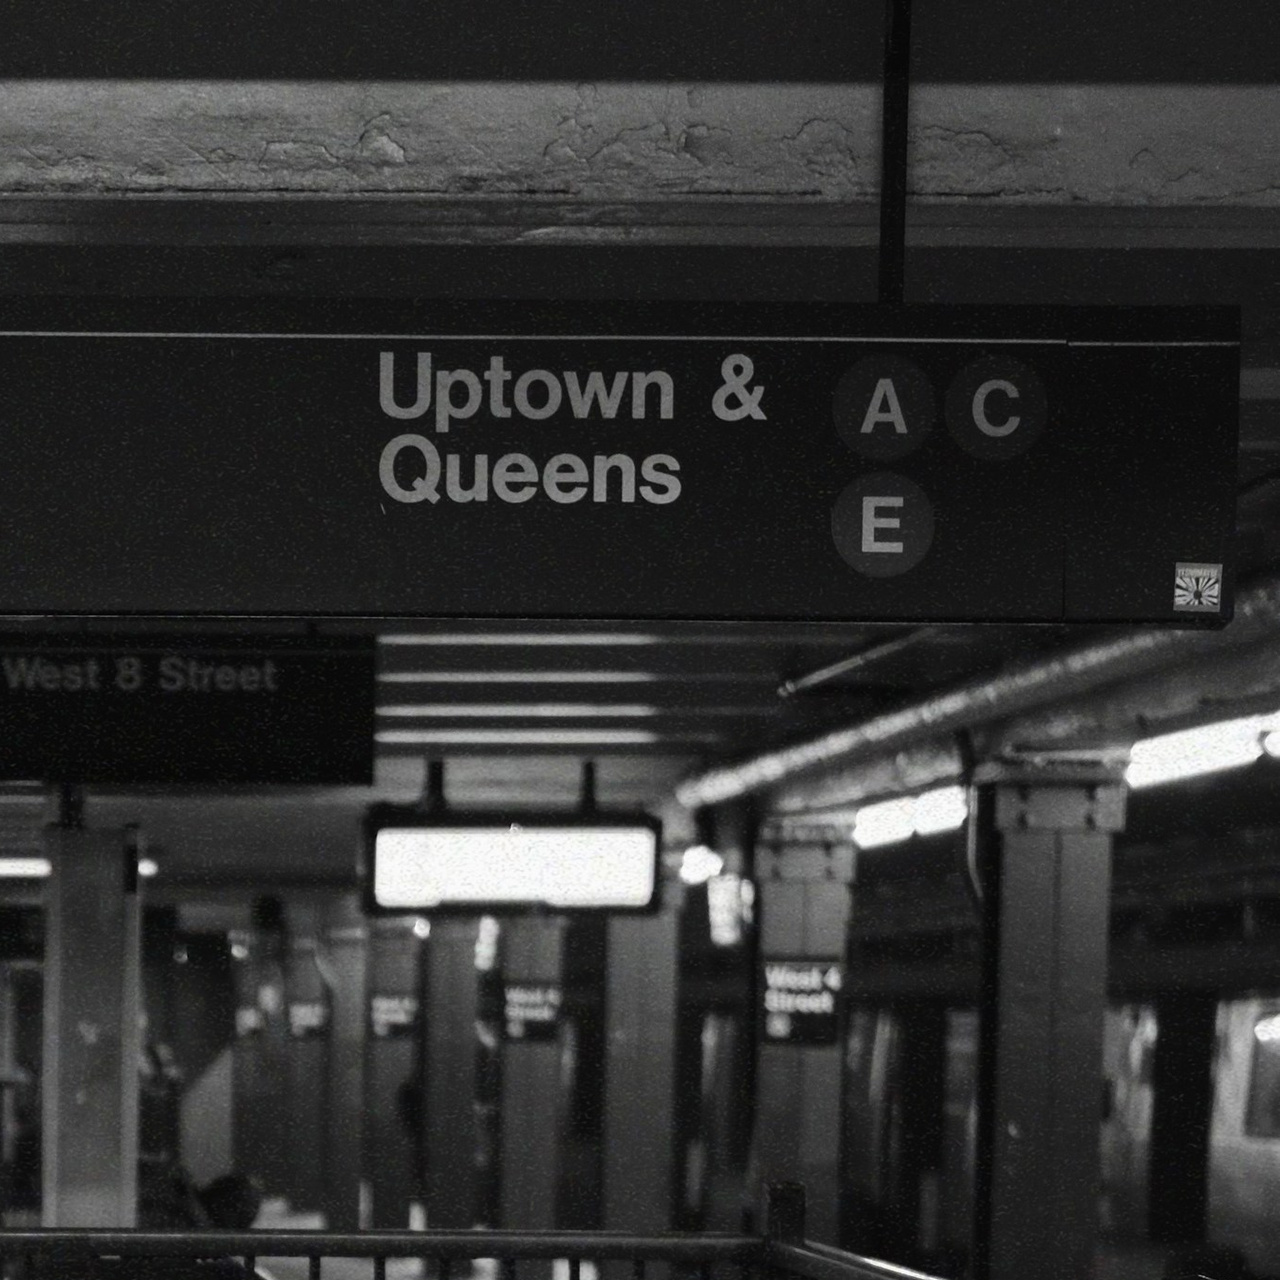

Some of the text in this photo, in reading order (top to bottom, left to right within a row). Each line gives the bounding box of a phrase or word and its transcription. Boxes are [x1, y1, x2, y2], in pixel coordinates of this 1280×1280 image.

[379, 352, 767, 432] Uptown &
[860, 378, 1021, 437] A C
[378, 433, 682, 504] Queens
[861, 496, 904, 553] E
[1, 656, 100, 691] West
[159, 656, 278, 691] Street
[764, 989, 834, 1014] Street
[765, 965, 823, 991] West
